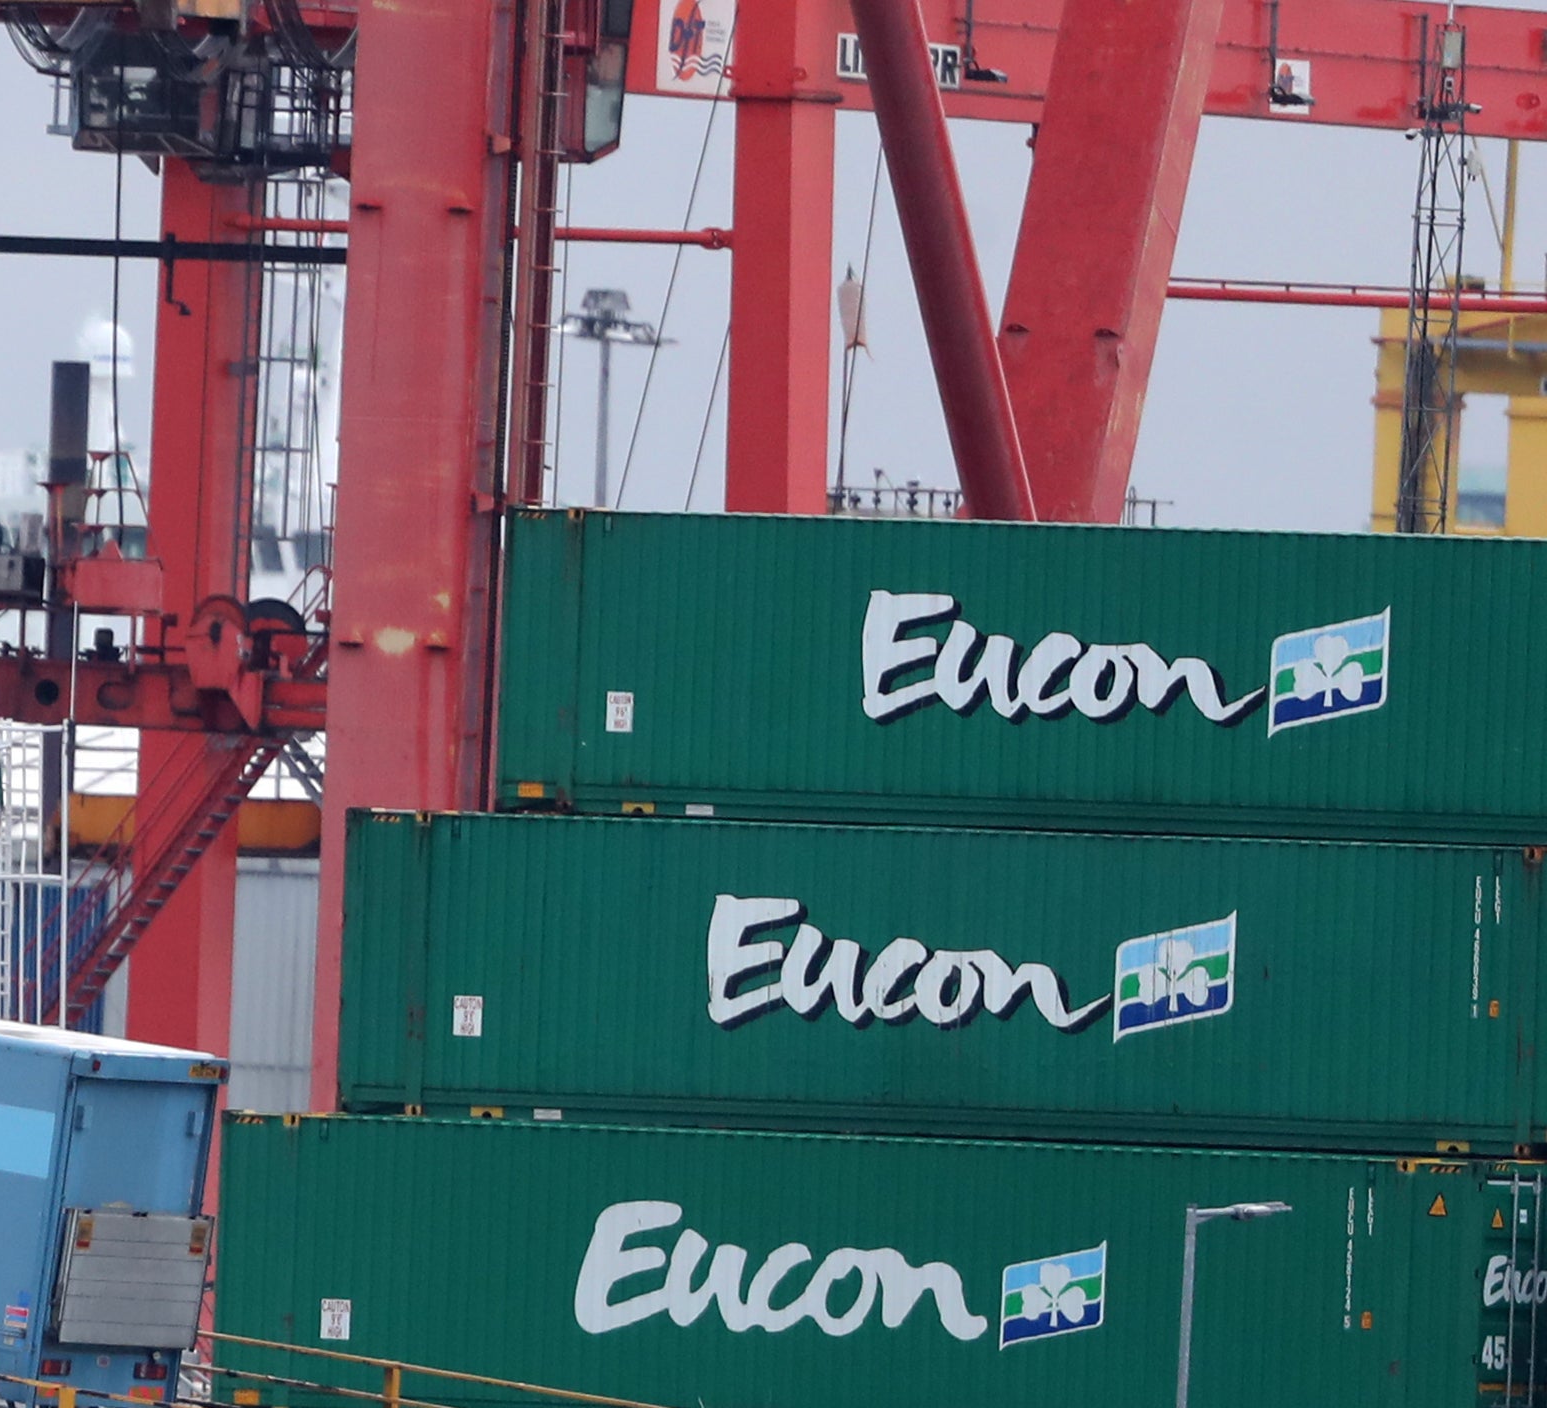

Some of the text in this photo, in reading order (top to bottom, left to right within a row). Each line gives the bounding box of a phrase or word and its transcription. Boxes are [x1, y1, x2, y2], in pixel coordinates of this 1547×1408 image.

[862, 590, 1265, 724] Eucon
[708, 894, 1111, 1034] Eucon
[574, 1201, 987, 1340] Eucon
[1483, 1255, 1547, 1306] Euco
